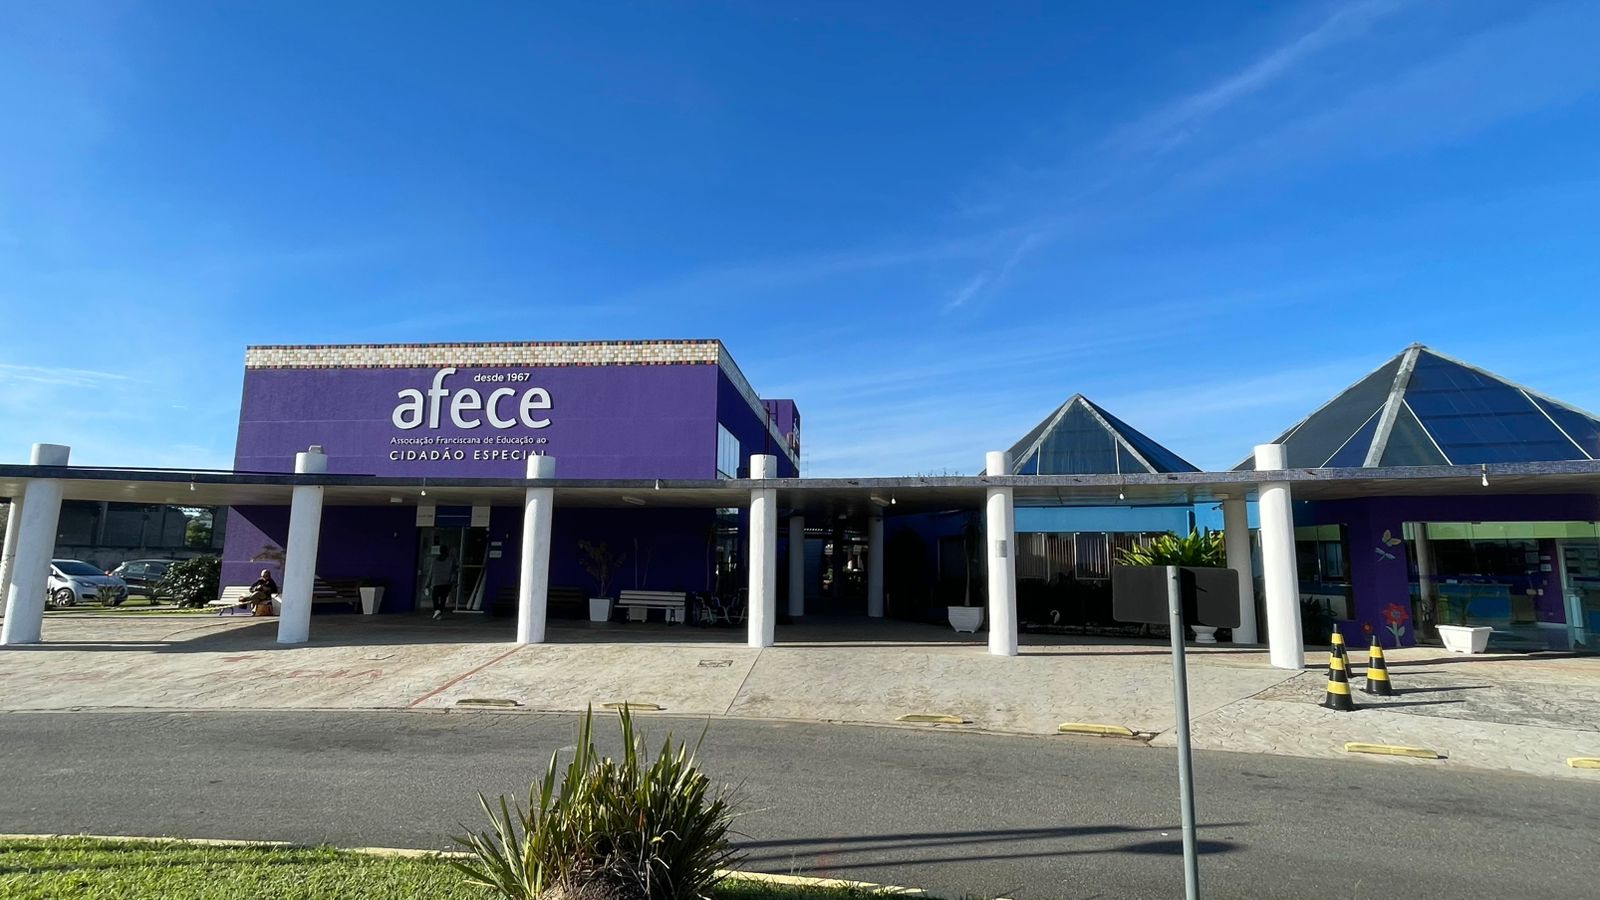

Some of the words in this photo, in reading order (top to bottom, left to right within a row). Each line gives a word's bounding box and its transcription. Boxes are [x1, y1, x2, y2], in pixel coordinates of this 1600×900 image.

[474, 373, 504, 382] desde
[507, 373, 530, 382] 1967
[392, 367, 552, 429] afece
[390, 436, 433, 445] Associação
[436, 436, 480, 444] Franciscana
[483, 436, 493, 444] de
[496, 435, 533, 445] Educação
[389, 447, 465, 460] CIDADÃO
